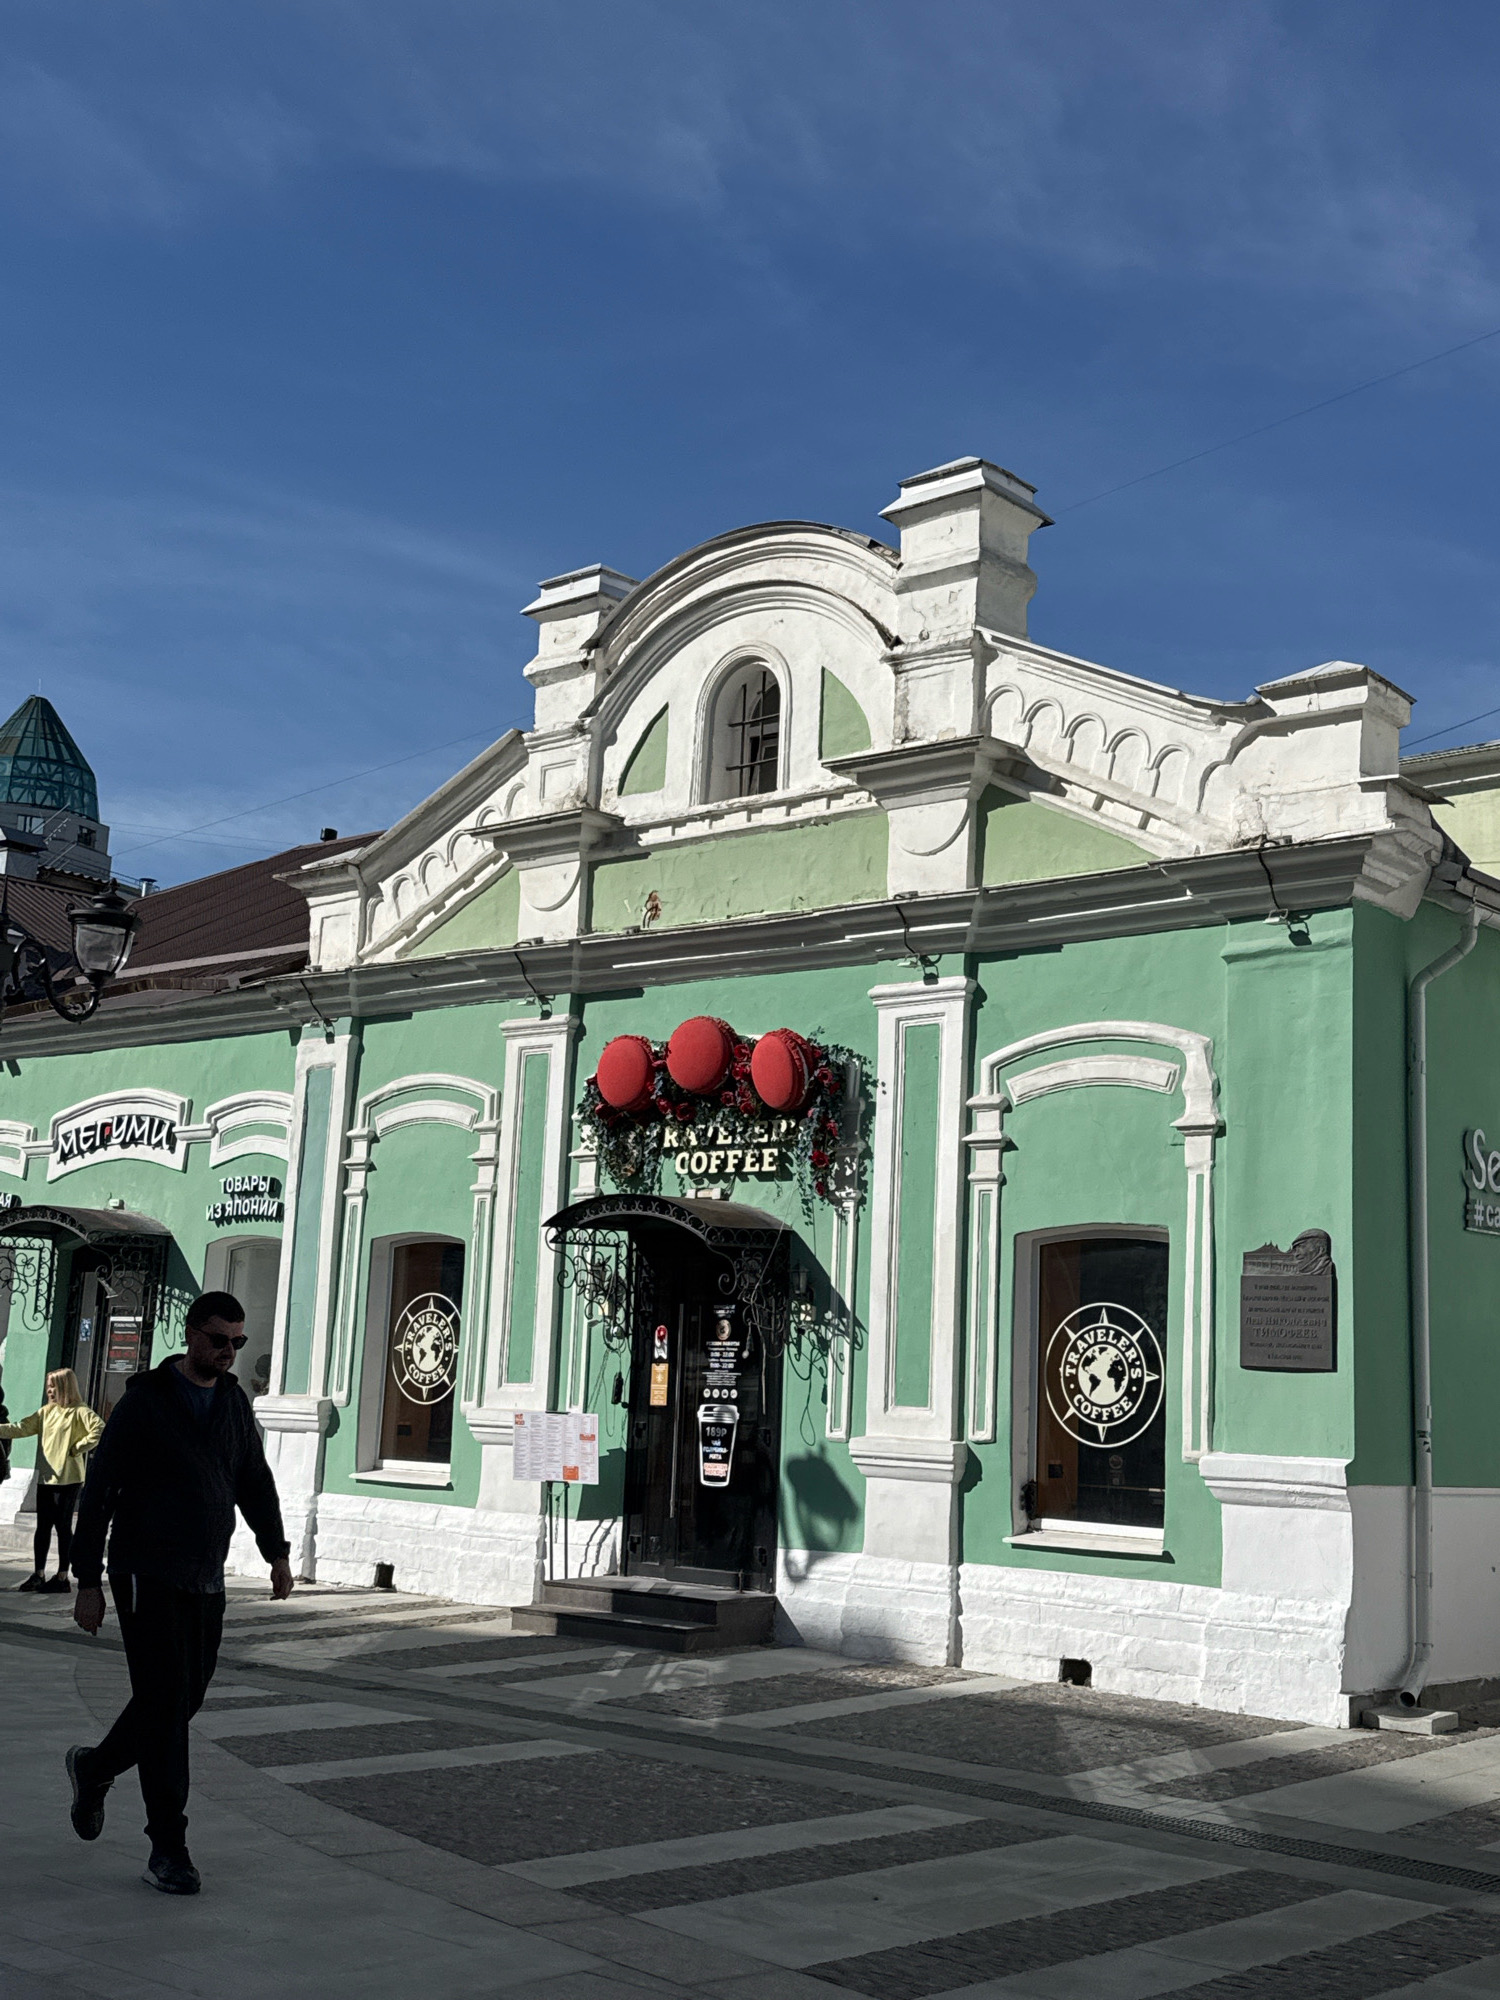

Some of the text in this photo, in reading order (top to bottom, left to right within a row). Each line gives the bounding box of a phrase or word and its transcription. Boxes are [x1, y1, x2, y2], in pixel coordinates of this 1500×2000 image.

[58, 1115, 171, 1152] МЕГУМИ
[675, 1148, 779, 1175] COFFEE
[219, 1175, 271, 1194] ТОВАРЫ
[205, 1198, 278, 1221] ИЗ ЯПОНИИ
[404, 1312, 453, 1352] TRAVELER'S
[1065, 1328, 1143, 1380] TRAVELER'S
[408, 1364, 446, 1385] COFFEE
[1073, 1395, 1133, 1421] COFFEE
